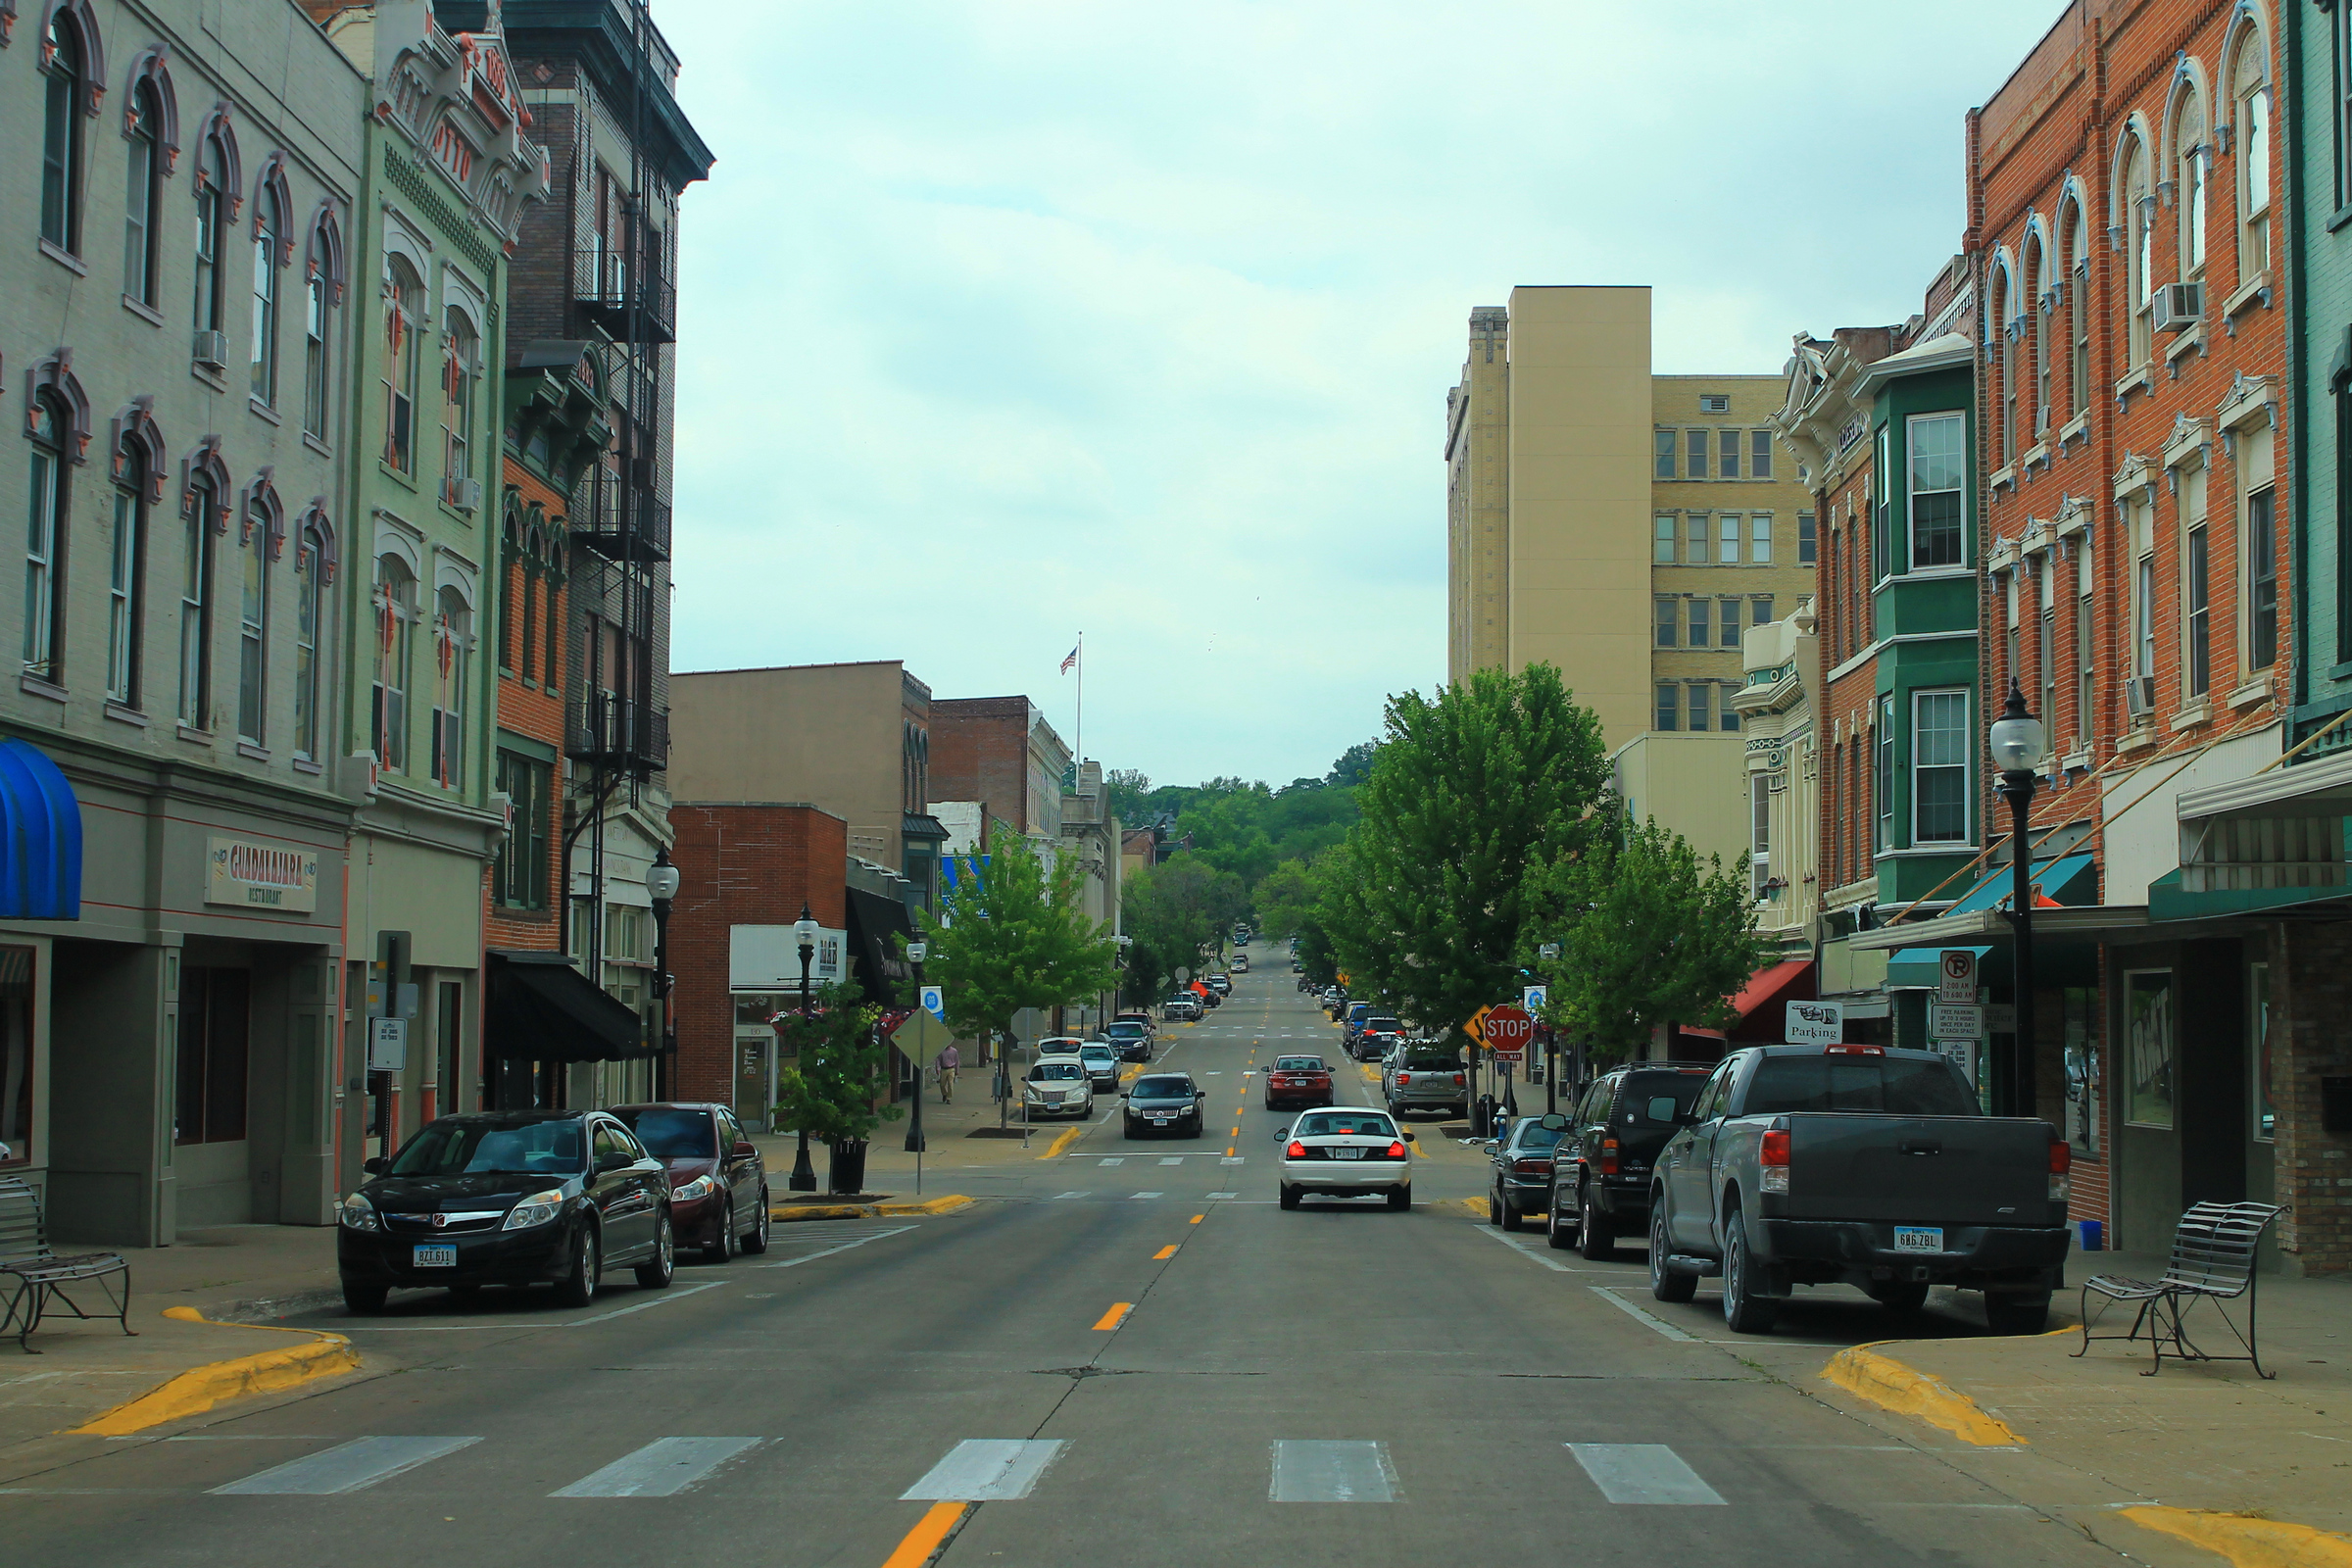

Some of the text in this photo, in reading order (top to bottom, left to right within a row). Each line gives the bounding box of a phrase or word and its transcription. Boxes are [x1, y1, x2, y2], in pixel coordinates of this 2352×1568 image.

[433, 124, 470, 181] OTTO
[230, 845, 303, 888] GUADALAJARA
[1487, 1019, 1530, 1037] STOP
[1791, 1026, 1838, 1041] Parking
[1919, 1234, 1936, 1247] ZBL
[418, 1250, 450, 1262] BZT 611
